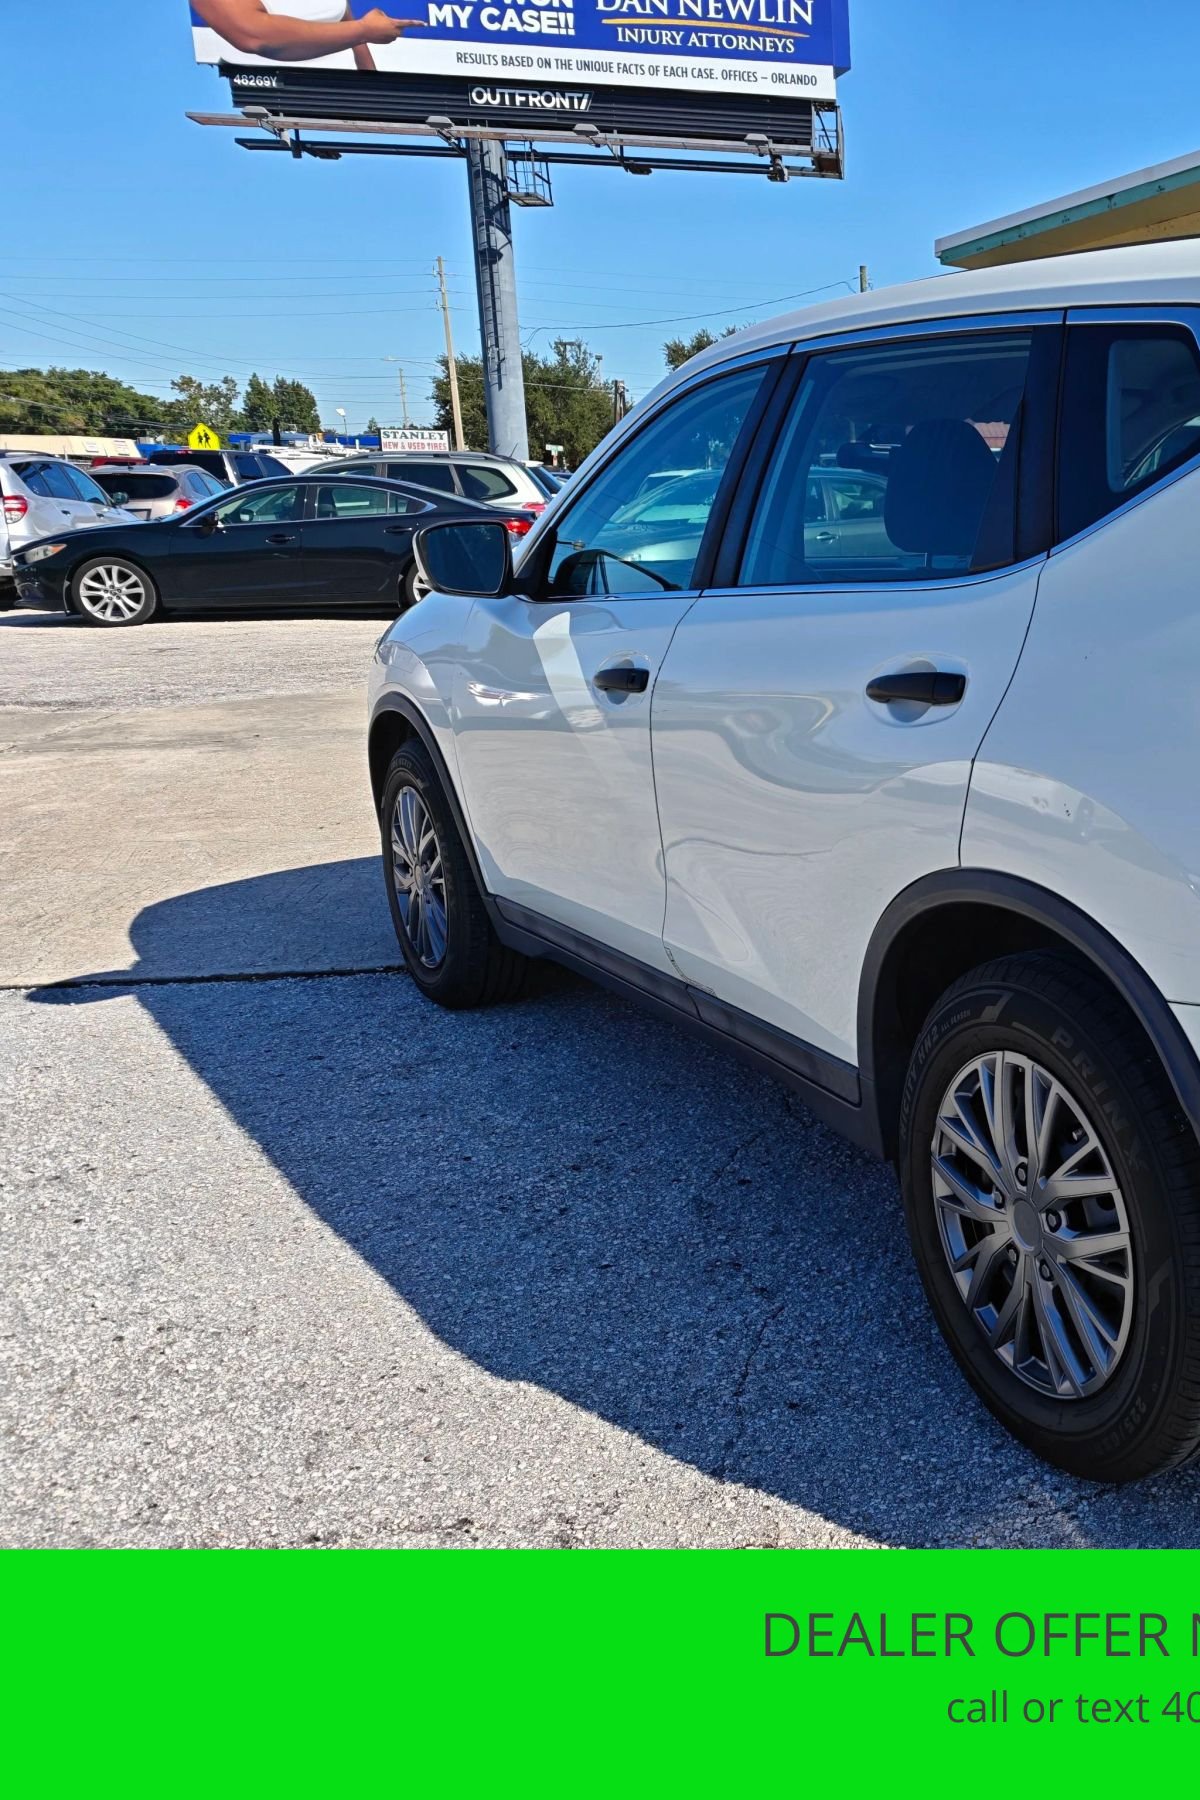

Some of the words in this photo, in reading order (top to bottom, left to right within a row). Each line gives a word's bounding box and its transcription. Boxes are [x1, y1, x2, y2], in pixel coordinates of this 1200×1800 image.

[428, 3, 474, 28] MY
[480, 6, 576, 36] CASE!!
[678, 0, 813, 25] NEWLIN
[617, 27, 685, 46] INJURY
[687, 31, 795, 53] ATTORNEYS
[233, 73, 277, 88] 48269Y
[456, 52, 498, 66] RESULTS
[501, 55, 534, 69] BASED
[537, 57, 551, 69] ON
[555, 58, 573, 71] THE
[576, 60, 614, 73] UNIQUE
[617, 62, 645, 75] FACTS
[648, 64, 661, 76] OF
[663, 66, 688, 78] EACH
[691, 67, 719, 80] CASE.
[721, 69, 758, 83] OFFICES
[771, 72, 818, 86] ORLANDO
[382, 431, 446, 440] STANLEY
[383, 441, 399, 450] NEW
[400, 442, 406, 450] &
[407, 442, 426, 451] USED
[427, 442, 447, 451] TIRES
